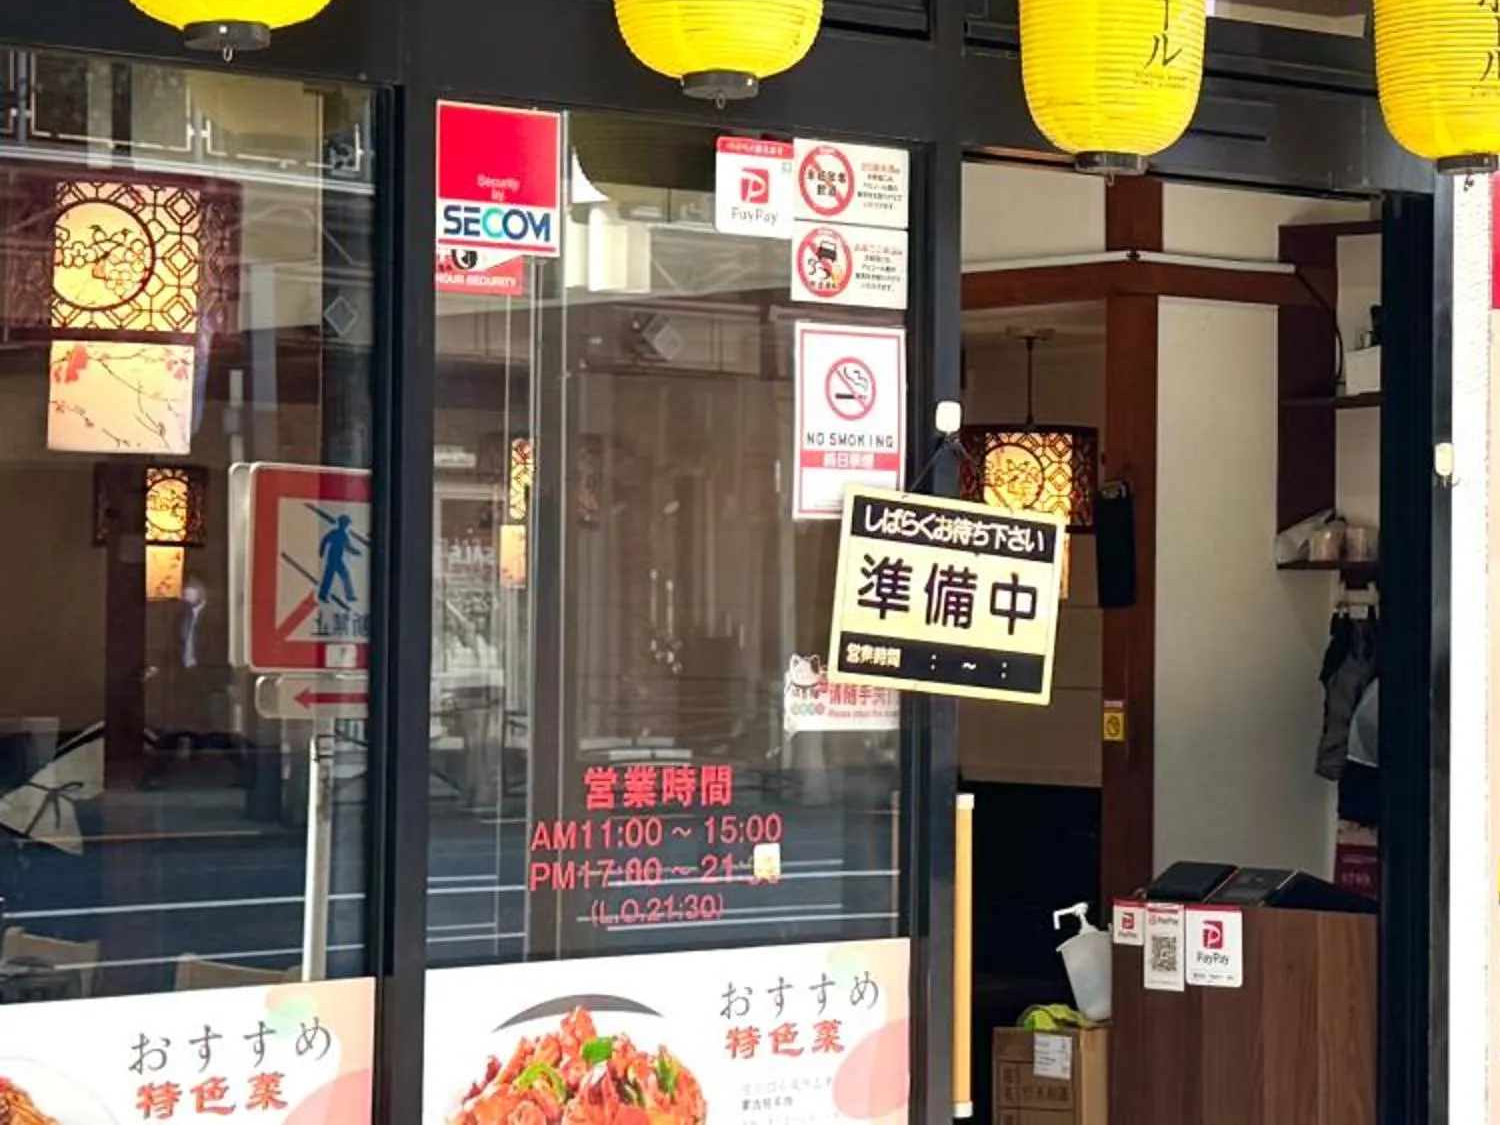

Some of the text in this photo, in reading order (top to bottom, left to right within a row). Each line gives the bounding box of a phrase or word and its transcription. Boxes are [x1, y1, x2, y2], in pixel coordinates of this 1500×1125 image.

[443, 204, 551, 243] SECOM
[731, 206, 779, 227] PayPay
[806, 431, 894, 449] NO SMOKING
[864, 504, 1045, 553] しばらくお待ち下さい
[856, 553, 1038, 636] 準備中
[583, 764, 734, 811] 営業時間
[530, 817, 664, 852] AM11:00
[704, 812, 783, 845] 15:00
[529, 856, 664, 892] PM17:00
[1197, 950, 1229, 965] PayPay
[719, 970, 879, 1020] おすすめ
[127, 1016, 332, 1076] おすすめ
[725, 1018, 845, 1060] 特色菜
[135, 1071, 288, 1120] 特色菜
